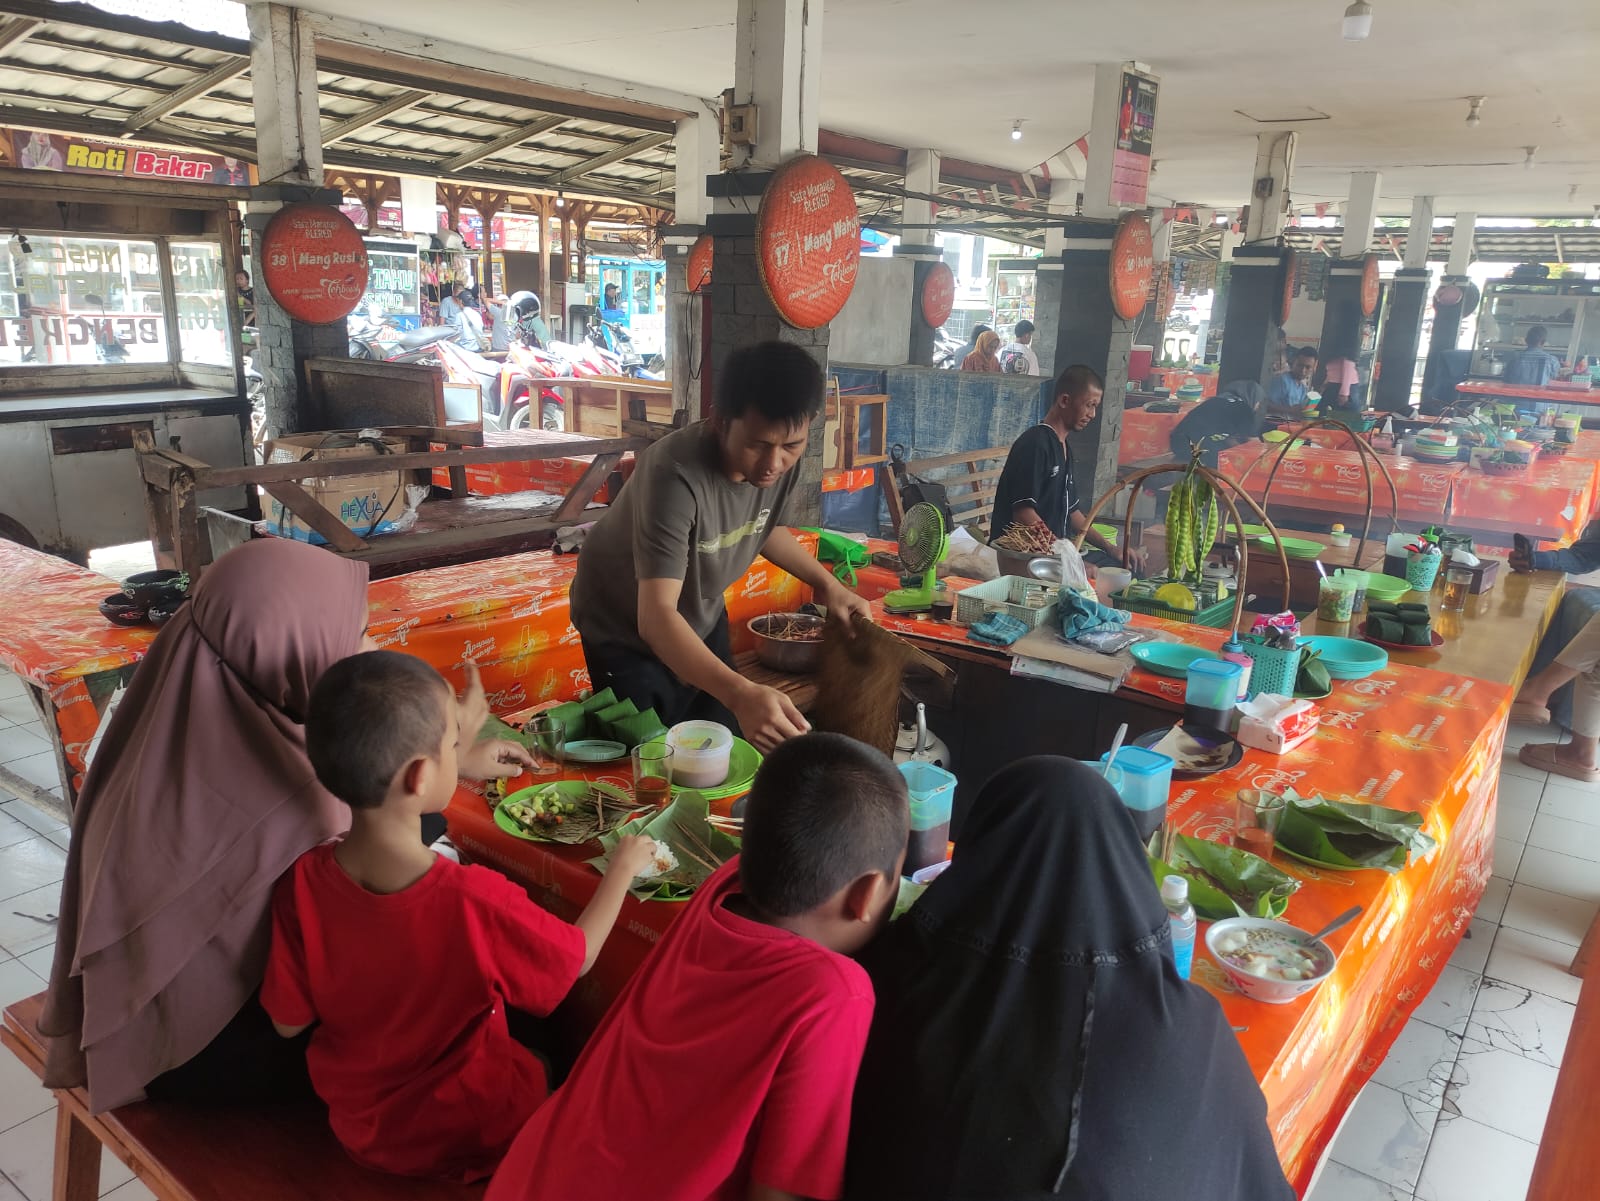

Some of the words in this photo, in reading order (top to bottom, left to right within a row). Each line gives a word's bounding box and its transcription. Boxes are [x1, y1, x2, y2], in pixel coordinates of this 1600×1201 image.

[67, 144, 127, 171] Roti
[134, 151, 212, 180] Bakar
[271, 255, 287, 266] 38
[300, 252, 330, 270] Mang
[775, 244, 790, 267] 17
[804, 232, 832, 254] Mang
[373, 268, 413, 291] TAHU
